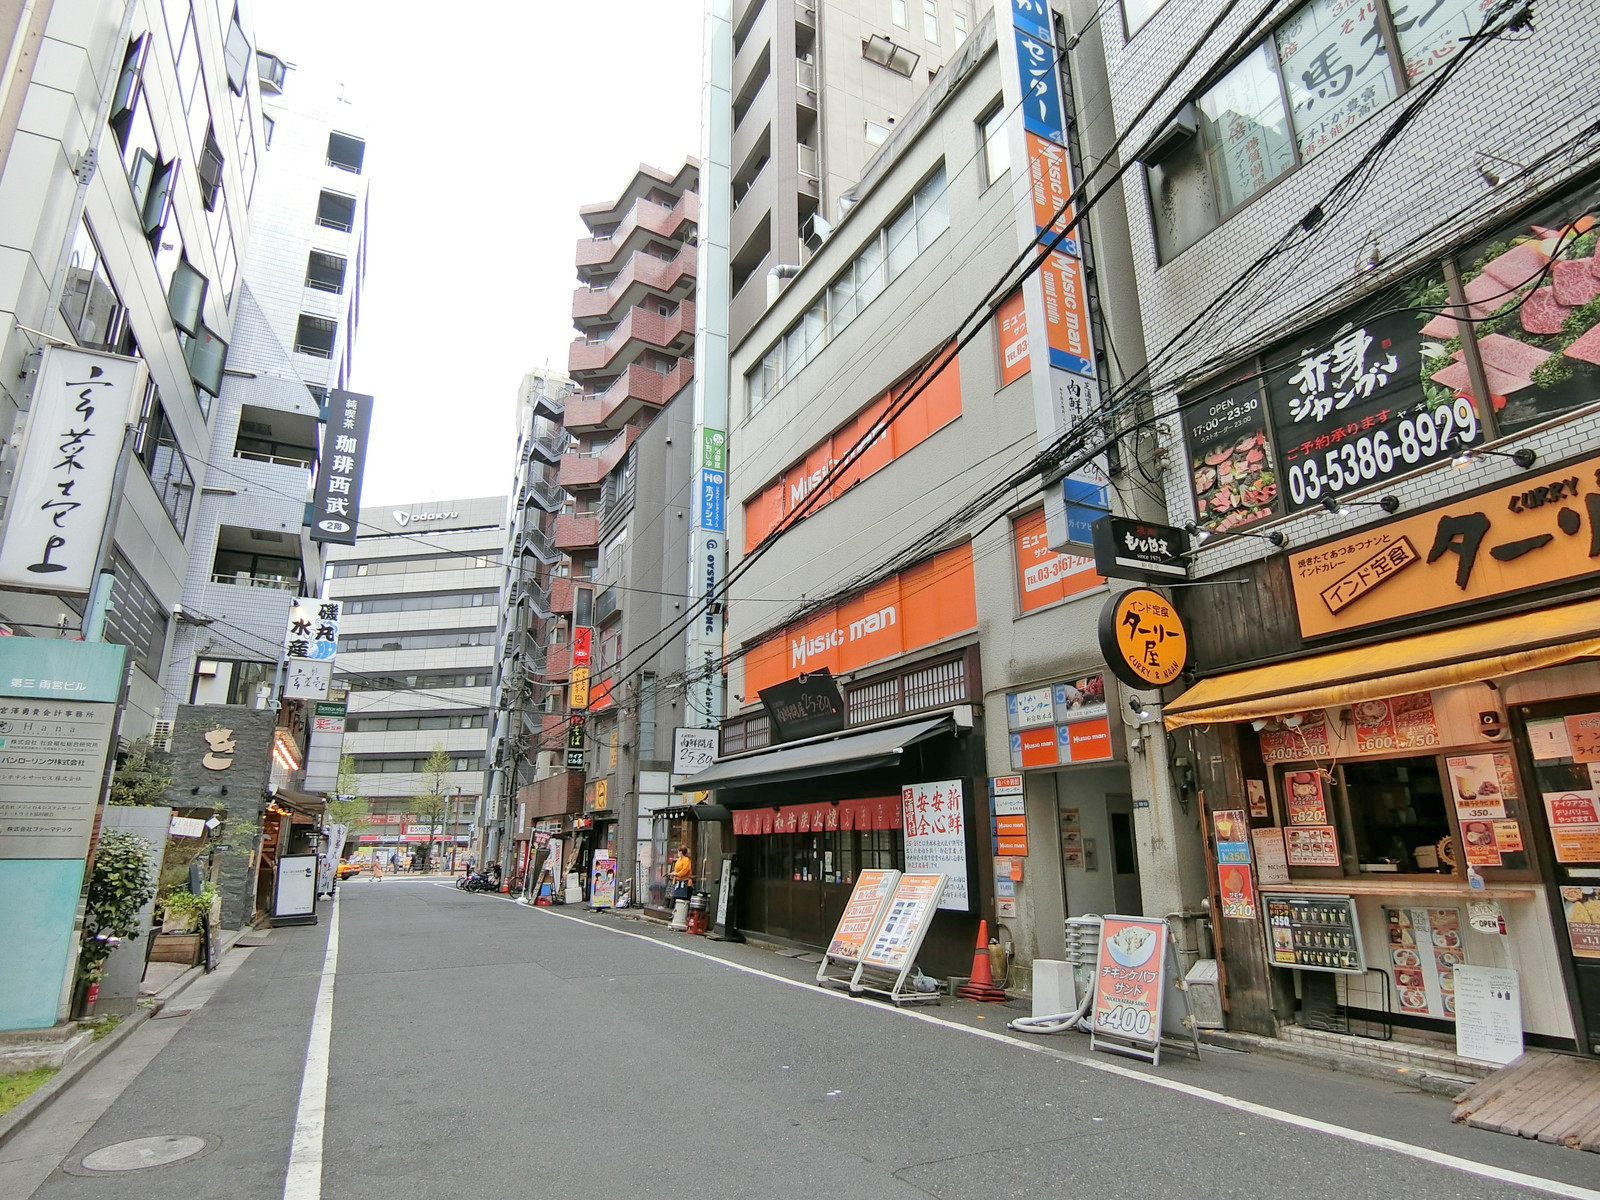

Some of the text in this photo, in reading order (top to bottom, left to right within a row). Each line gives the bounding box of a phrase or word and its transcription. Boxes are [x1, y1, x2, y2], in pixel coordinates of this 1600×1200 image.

[1020, 39, 1049, 123] センター
[1030, 156, 1047, 206] sound studio
[1037, 137, 1067, 234] Music man
[1065, 238, 1077, 256] 3
[1043, 271, 1059, 325] sound studio
[1051, 250, 1083, 354] Music man
[1079, 358, 1092, 376] 2
[1288, 327, 1374, 395] 赤身
[344, 398, 357, 430] 純喫茶
[1209, 398, 1234, 416] OPEN
[1200, 415, 1252, 444] ラストオーダー 23:00
[1287, 409, 1391, 462] ご予約承ります
[1288, 397, 1477, 505] 03-5386-8929
[325, 434, 357, 516] 珈琲西武
[1097, 487, 1109, 506] 1
[1507, 476, 1580, 514] CURRY
[410, 510, 459, 522] odakyu
[326, 521, 343, 532] 2階
[1022, 532, 1048, 549] ミュー
[1297, 534, 1391, 569] 焼きたてあつあつナンと
[1299, 561, 1346, 578] インドカレー
[1330, 545, 1410, 603] インド定食
[1129, 601, 1170, 618] インド定食
[315, 603, 338, 642] 磯丸
[1122, 610, 1180, 643] ターリー
[287, 617, 311, 658] 水産
[791, 605, 896, 669] Music man
[1143, 640, 1160, 667] 屋
[1129, 655, 1151, 677] CURRY
[1163, 660, 1180, 679] NAAN
[10, 678, 87, 691] 第三 雨宮ビル
[1055, 688, 1066, 705] 5
[1022, 702, 1051, 713] センター
[1013, 734, 1022, 752] 2
[1059, 726, 1070, 744] 3
[1073, 734, 1091, 743] Music
[1361, 737, 1393, 751] ¥600
[1024, 740, 1054, 751] Music man
[1264, 748, 1292, 761] ¥400
[1298, 744, 1327, 758] ¥500
[916, 791, 930, 836] 安全
[931, 790, 946, 834] 安心
[947, 788, 962, 836] 新鮮
[1293, 810, 1322, 822] ¥820
[1555, 808, 1589, 816] デリバリー
[1223, 904, 1253, 916] ¥210
[1474, 903, 1494, 914] OPEN
[1270, 915, 1290, 926] ¥350
[1479, 919, 1498, 929] OPEN
[1101, 966, 1159, 983] チキンケバブ
[1115, 981, 1143, 997] サンド
[1121, 998, 1135, 1006] KEBAB
[1097, 1005, 1152, 1035] ¥400
